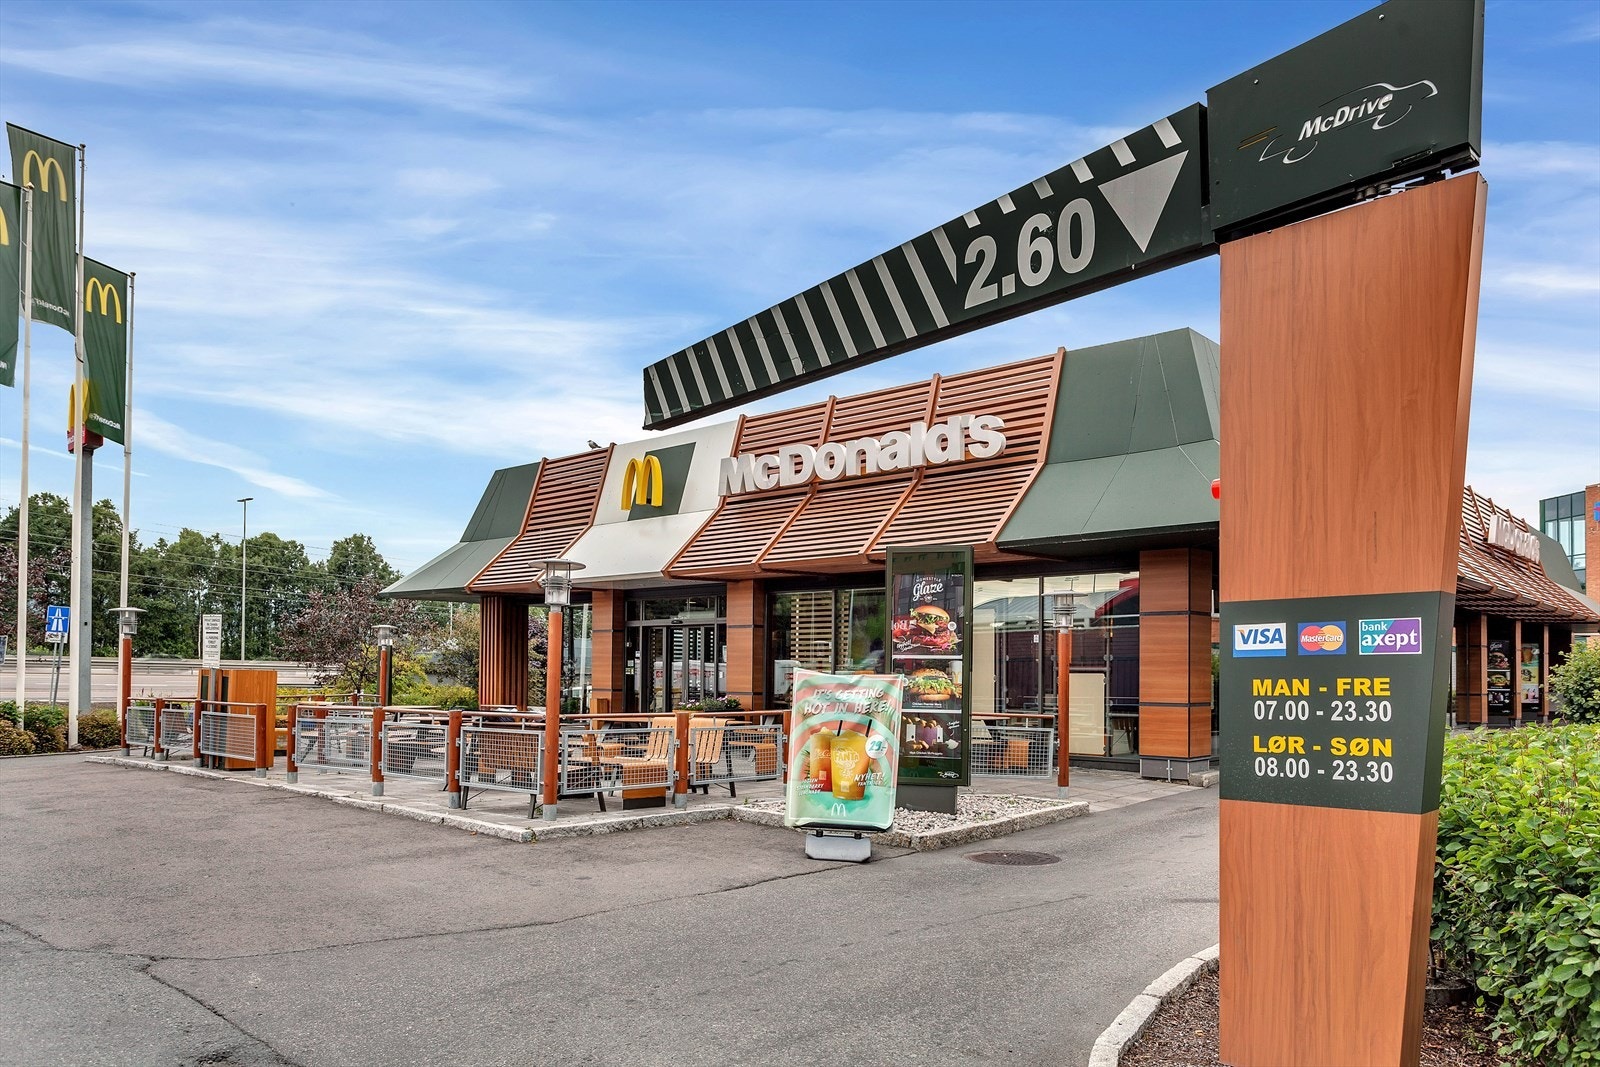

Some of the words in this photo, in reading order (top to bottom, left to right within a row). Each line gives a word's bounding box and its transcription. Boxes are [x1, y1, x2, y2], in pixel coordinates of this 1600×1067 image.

[1297, 92, 1394, 142] McDrive
[964, 197, 1096, 310] 2.60
[717, 413, 1007, 497] McDonald's
[912, 581, 944, 602] Glaze
[1238, 627, 1284, 645] VISA
[1361, 621, 1388, 631] bank
[1300, 633, 1344, 644] MasterCard
[1361, 630, 1418, 651] axept
[813, 689, 833, 700] IT'S
[834, 687, 885, 700] GETTING
[1252, 678, 1310, 696] MAN
[1336, 677, 1391, 696] FRE
[804, 702, 831, 715] HOT
[834, 702, 849, 714] IN
[854, 699, 892, 715] HERE!
[1253, 700, 1310, 721] 07.00
[1330, 700, 1392, 722] 23.30
[1252, 735, 1306, 754] LØR
[1330, 737, 1392, 757] SØN
[1254, 756, 1310, 778] 08.00
[1332, 759, 1394, 783] 23.30
